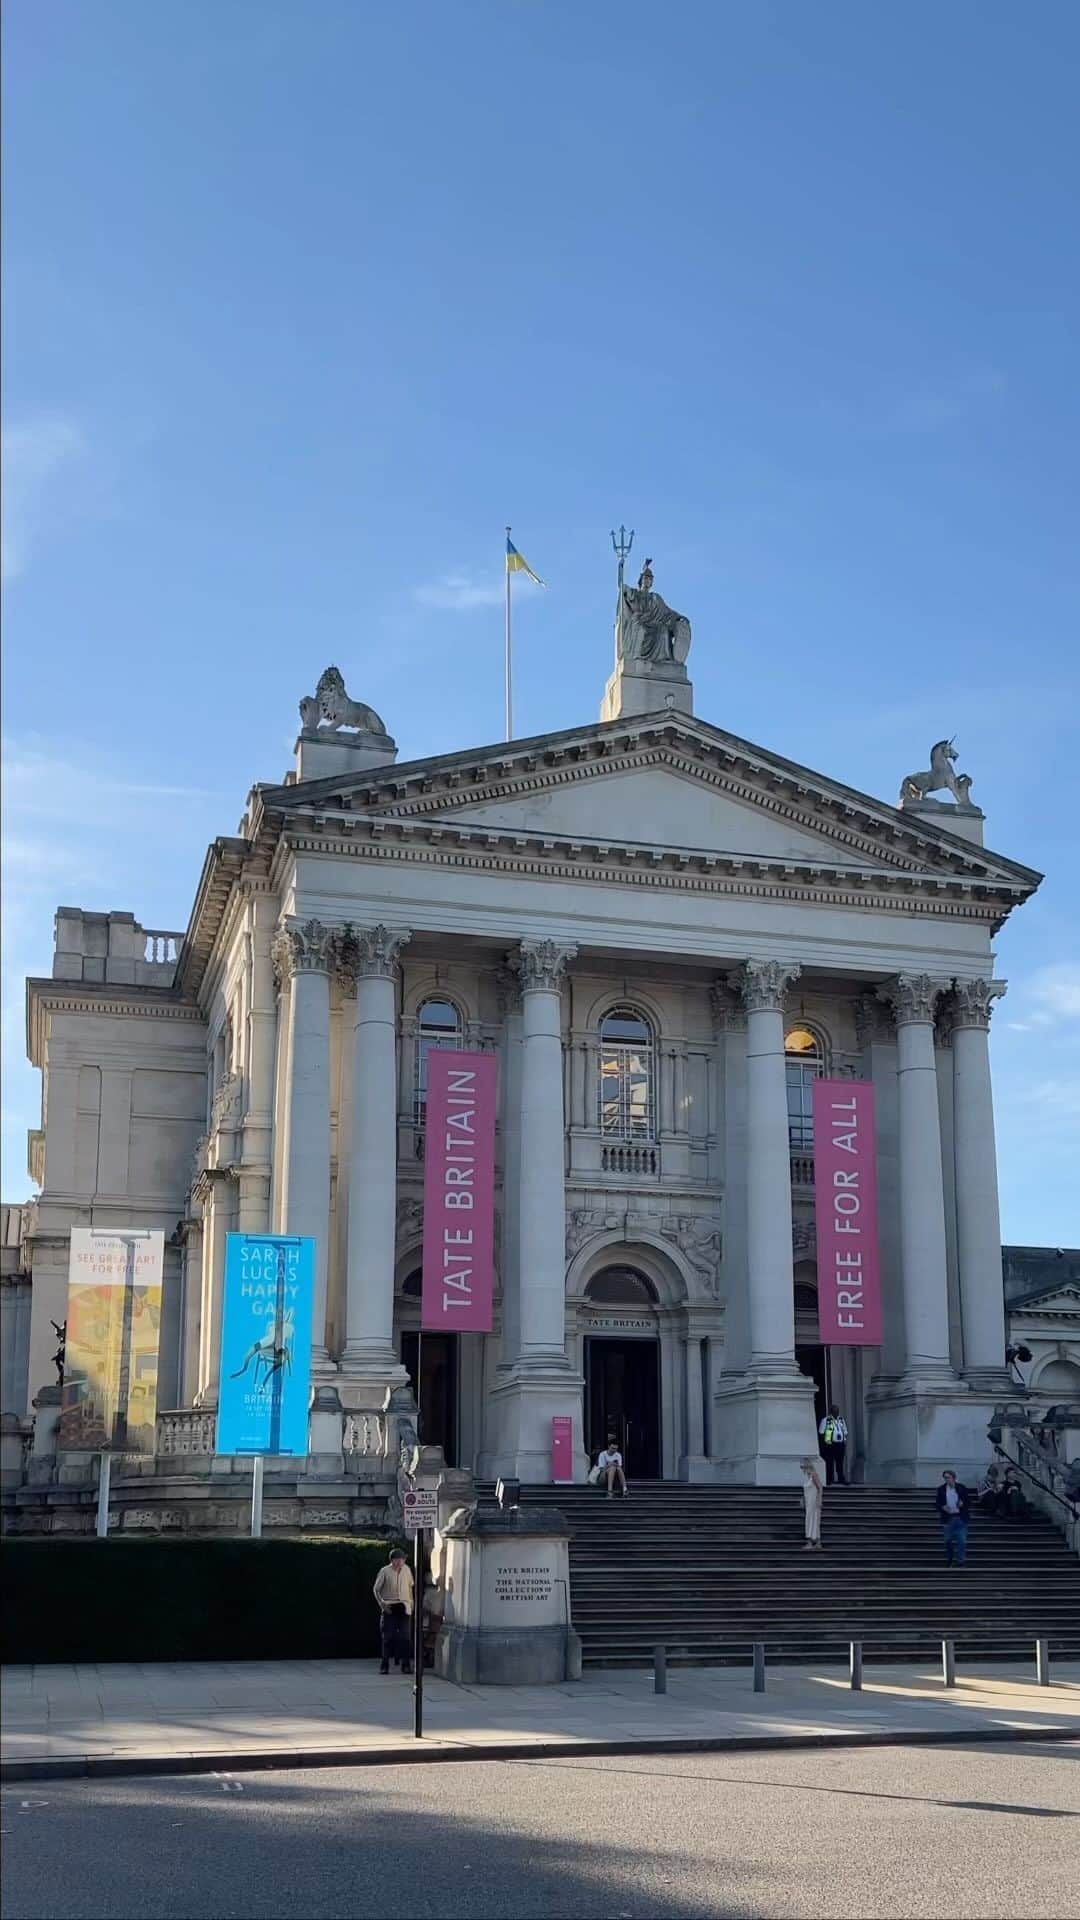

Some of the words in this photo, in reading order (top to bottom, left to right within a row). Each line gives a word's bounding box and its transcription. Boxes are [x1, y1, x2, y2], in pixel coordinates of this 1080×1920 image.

[445, 1070, 476, 1209] BRITAIN
[831, 1097, 858, 1154] ALL
[834, 1170, 861, 1233] FOR
[77, 1253, 95, 1263] SEE
[136, 1256, 156, 1265] ART
[92, 1264, 113, 1273] FOR
[240, 1247, 300, 1264] SARAH
[241, 1264, 297, 1282] LUCAS
[443, 1228, 473, 1312] TATE
[836, 1251, 864, 1328] FREE
[588, 1319, 610, 1327] TATE
[613, 1319, 651, 1328] BRITAIN
